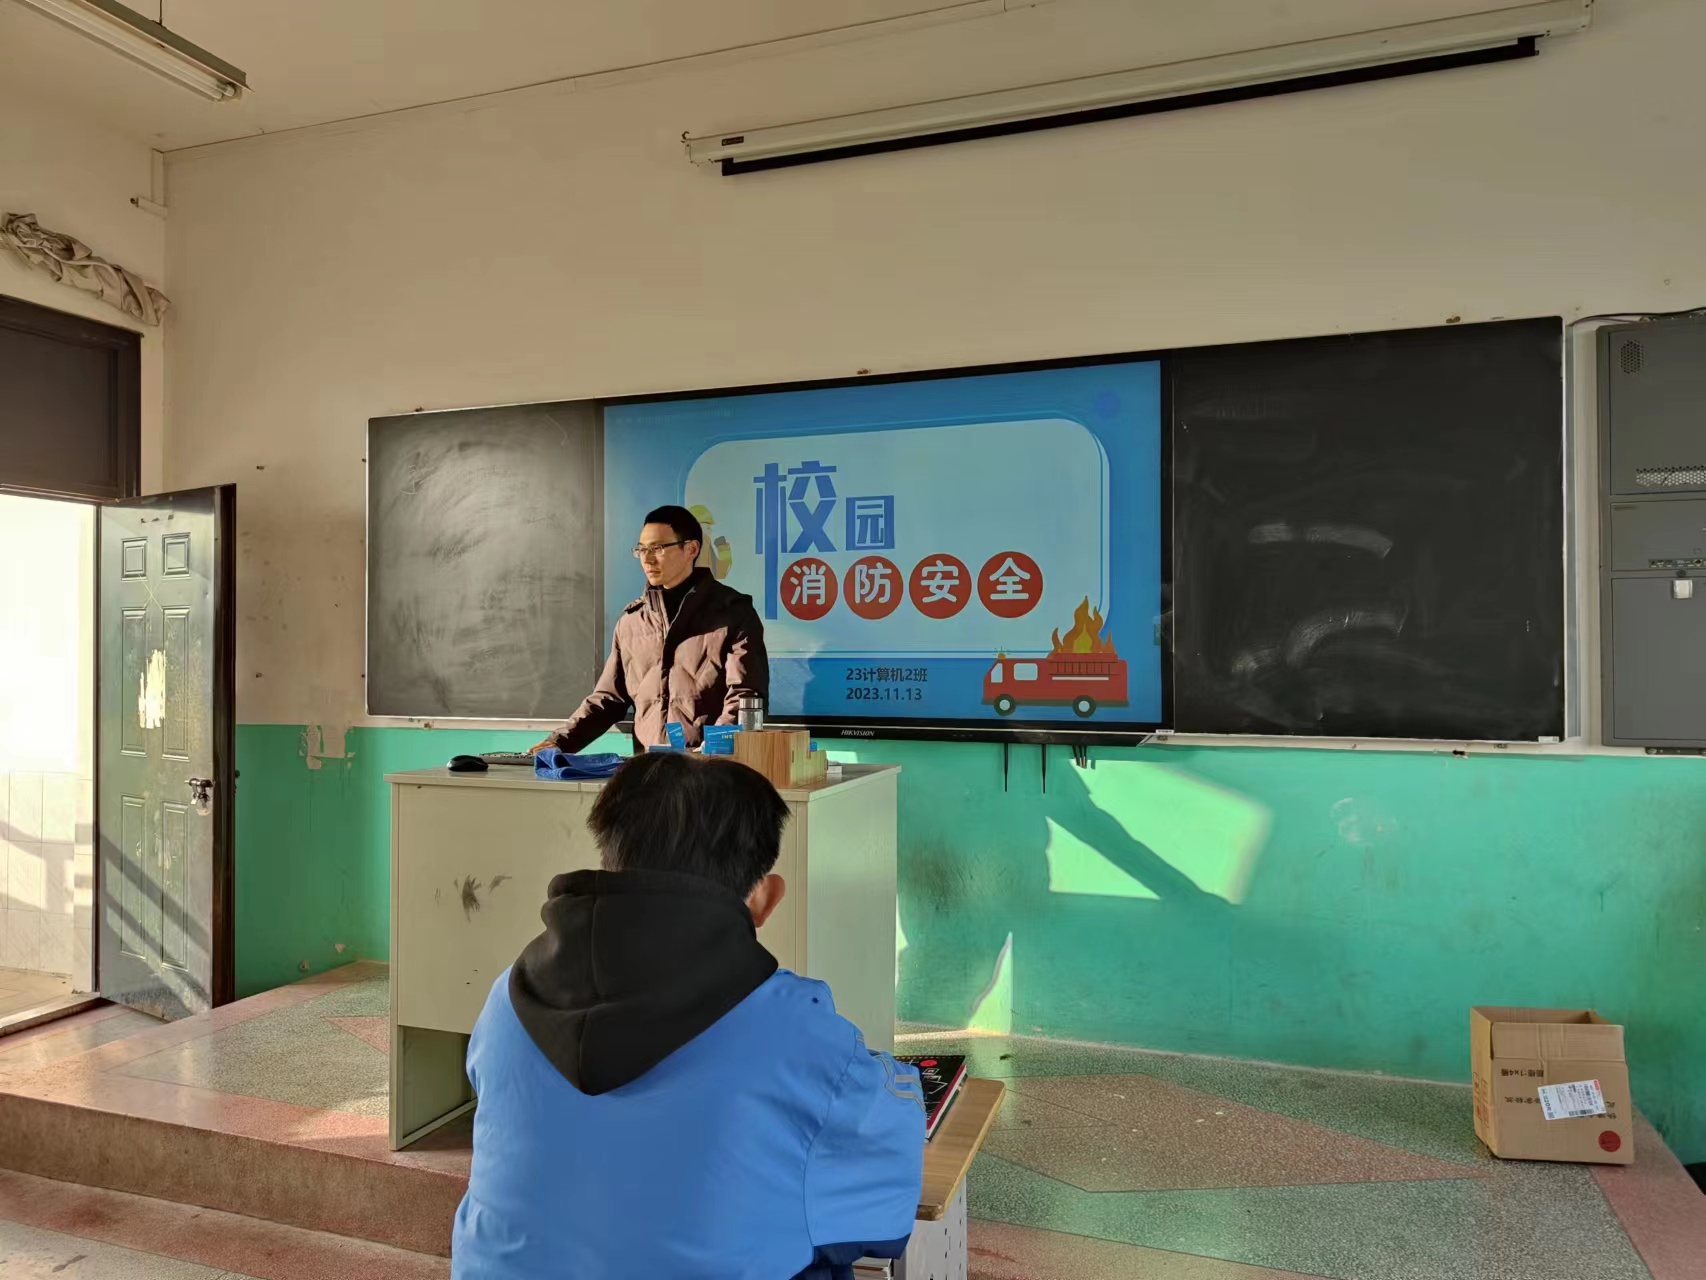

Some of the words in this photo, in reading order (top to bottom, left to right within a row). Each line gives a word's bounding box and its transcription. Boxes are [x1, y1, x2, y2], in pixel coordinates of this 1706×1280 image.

[753, 460, 895, 620] 校园
[789, 556, 1031, 606] 消防安全
[846, 667, 928, 682] 23计算机2班
[846, 687, 922, 701] 2023.11.13
[841, 729, 875, 737] HIKVISION
